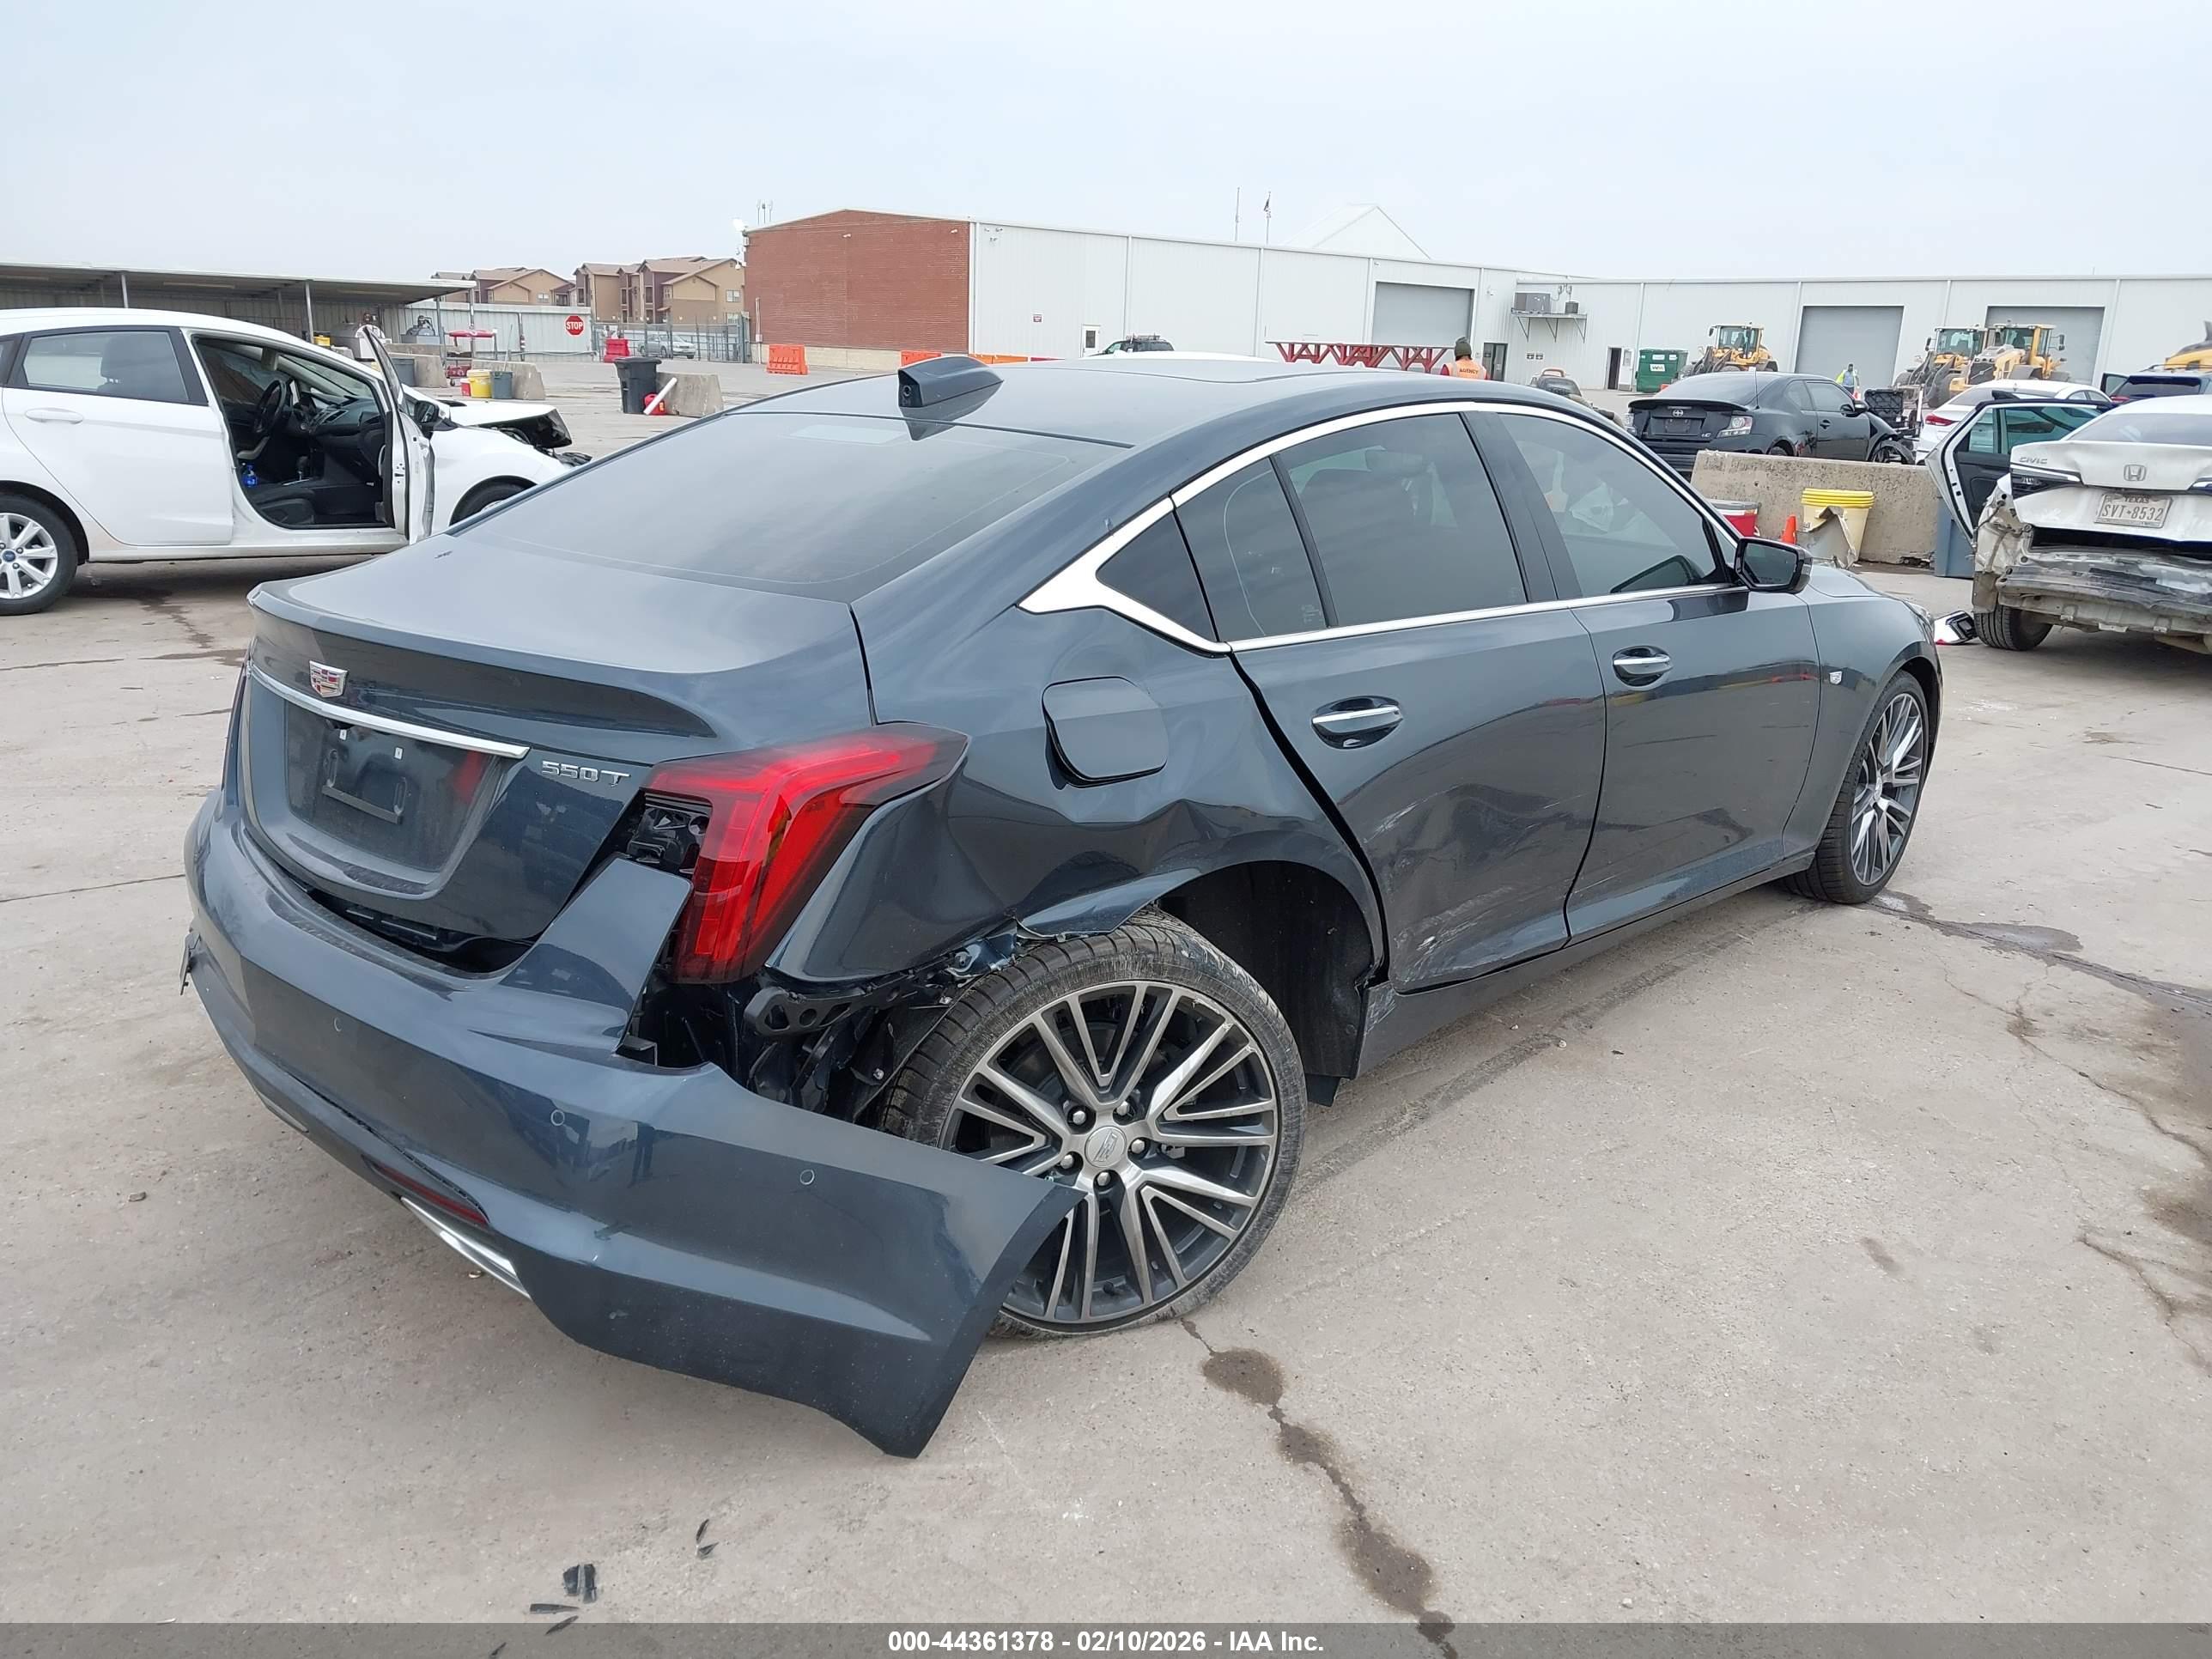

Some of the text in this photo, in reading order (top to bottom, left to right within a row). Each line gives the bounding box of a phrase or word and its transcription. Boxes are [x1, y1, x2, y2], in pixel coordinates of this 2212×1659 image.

[566, 321, 583, 330] STOP
[2124, 495, 2150, 504] TEXAS
[542, 760, 631, 787] 550T
